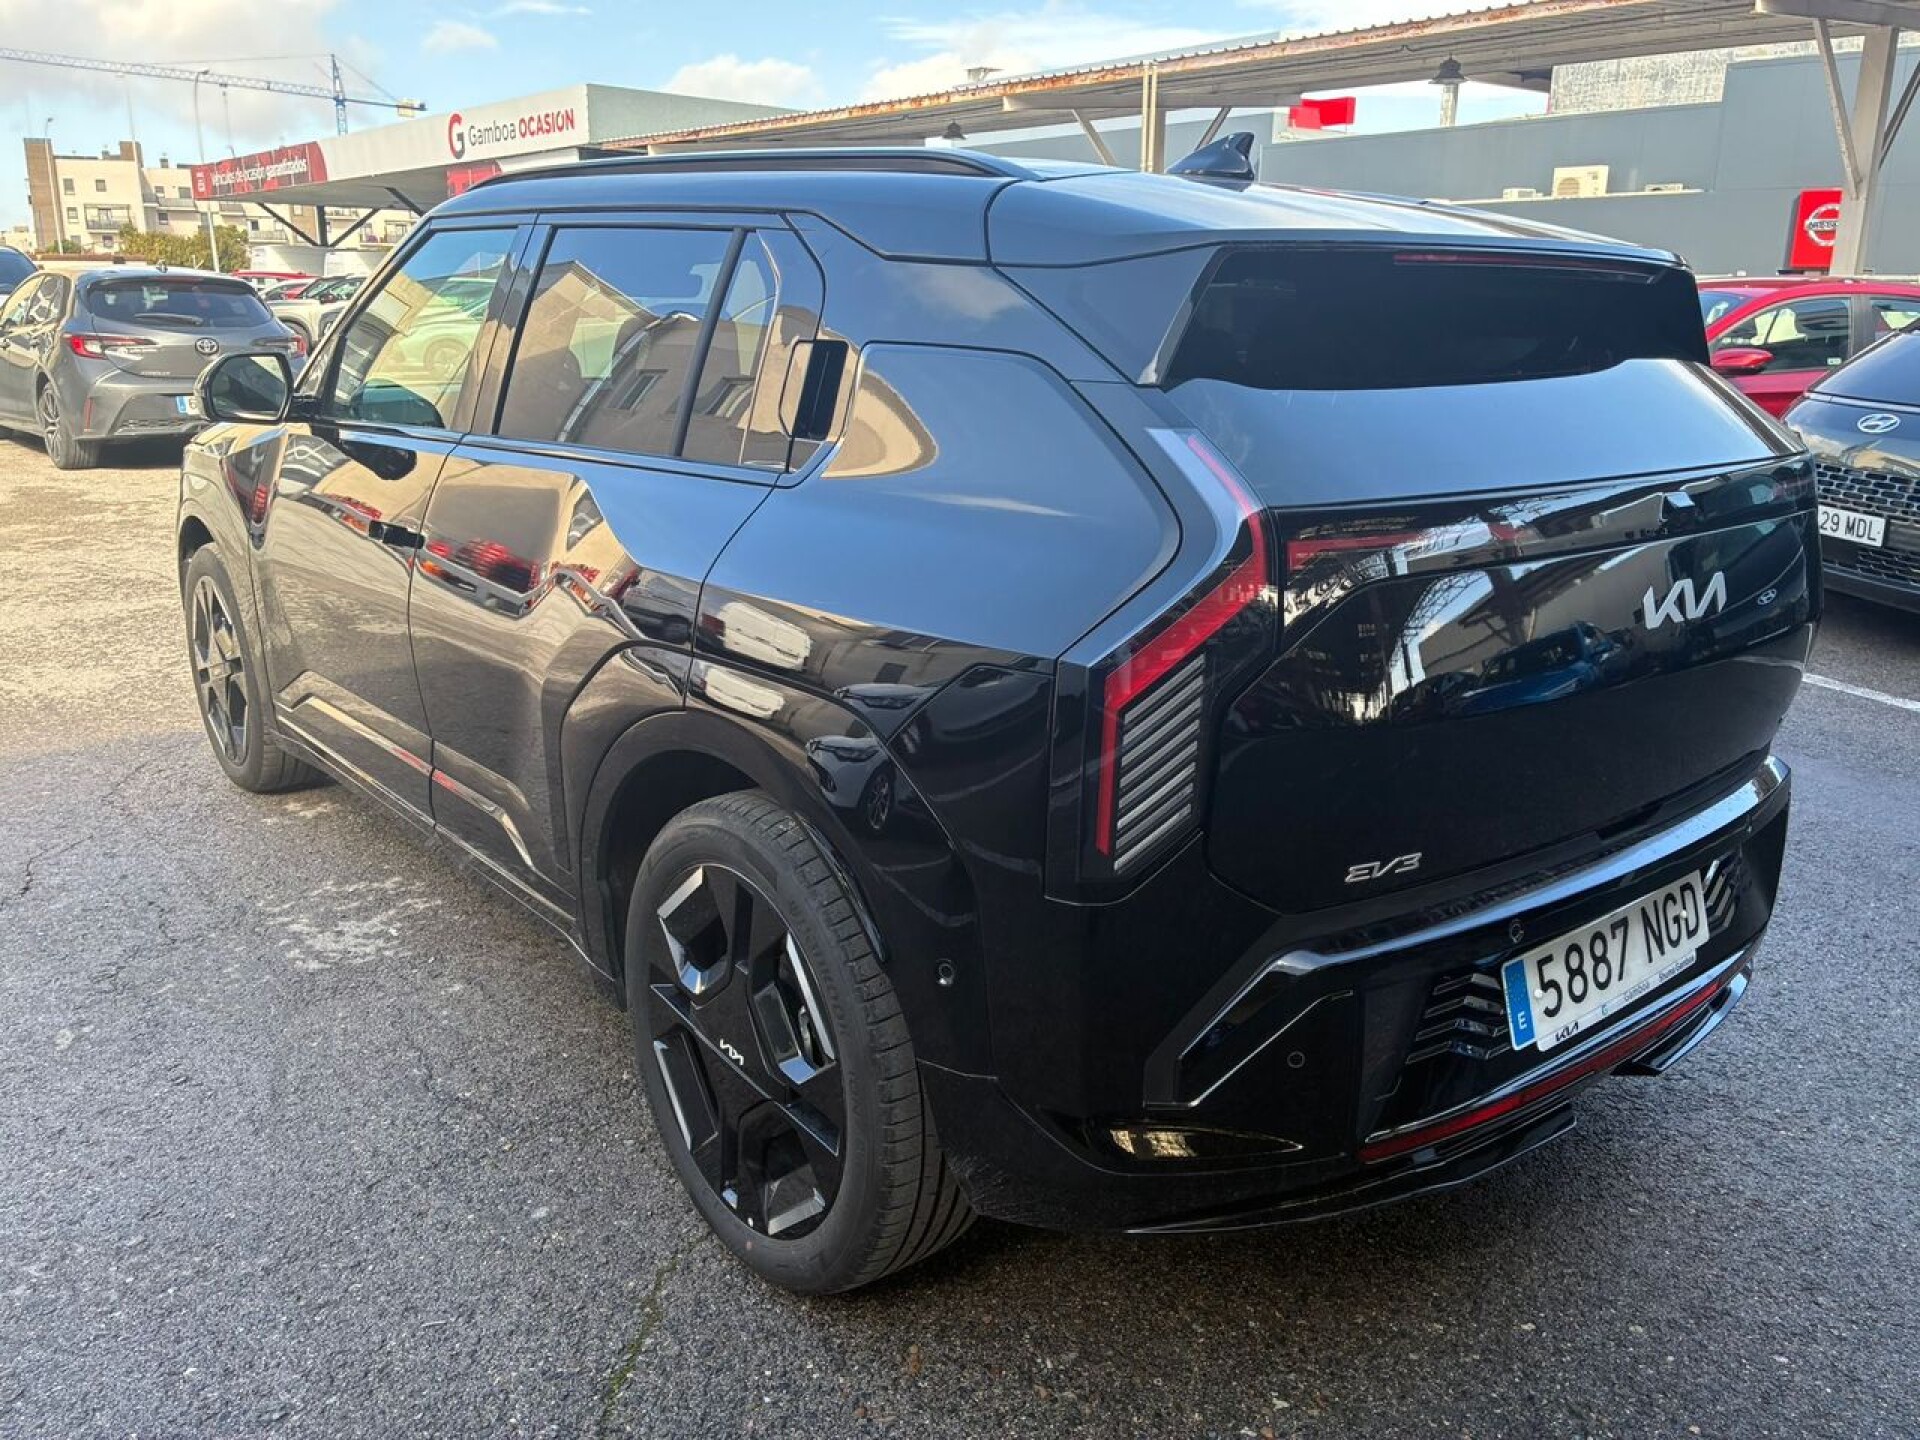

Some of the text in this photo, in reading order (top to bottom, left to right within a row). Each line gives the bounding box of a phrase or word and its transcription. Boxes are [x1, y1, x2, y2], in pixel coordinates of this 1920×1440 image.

[468, 120, 517, 146] Gamboa
[1820, 511, 1877, 541] 29 MDL
[1643, 571, 1727, 630] KIA
[1344, 852, 1422, 882] EV3
[1536, 882, 1699, 1017] 5887 NGD
[1517, 1011, 1527, 1030] E
